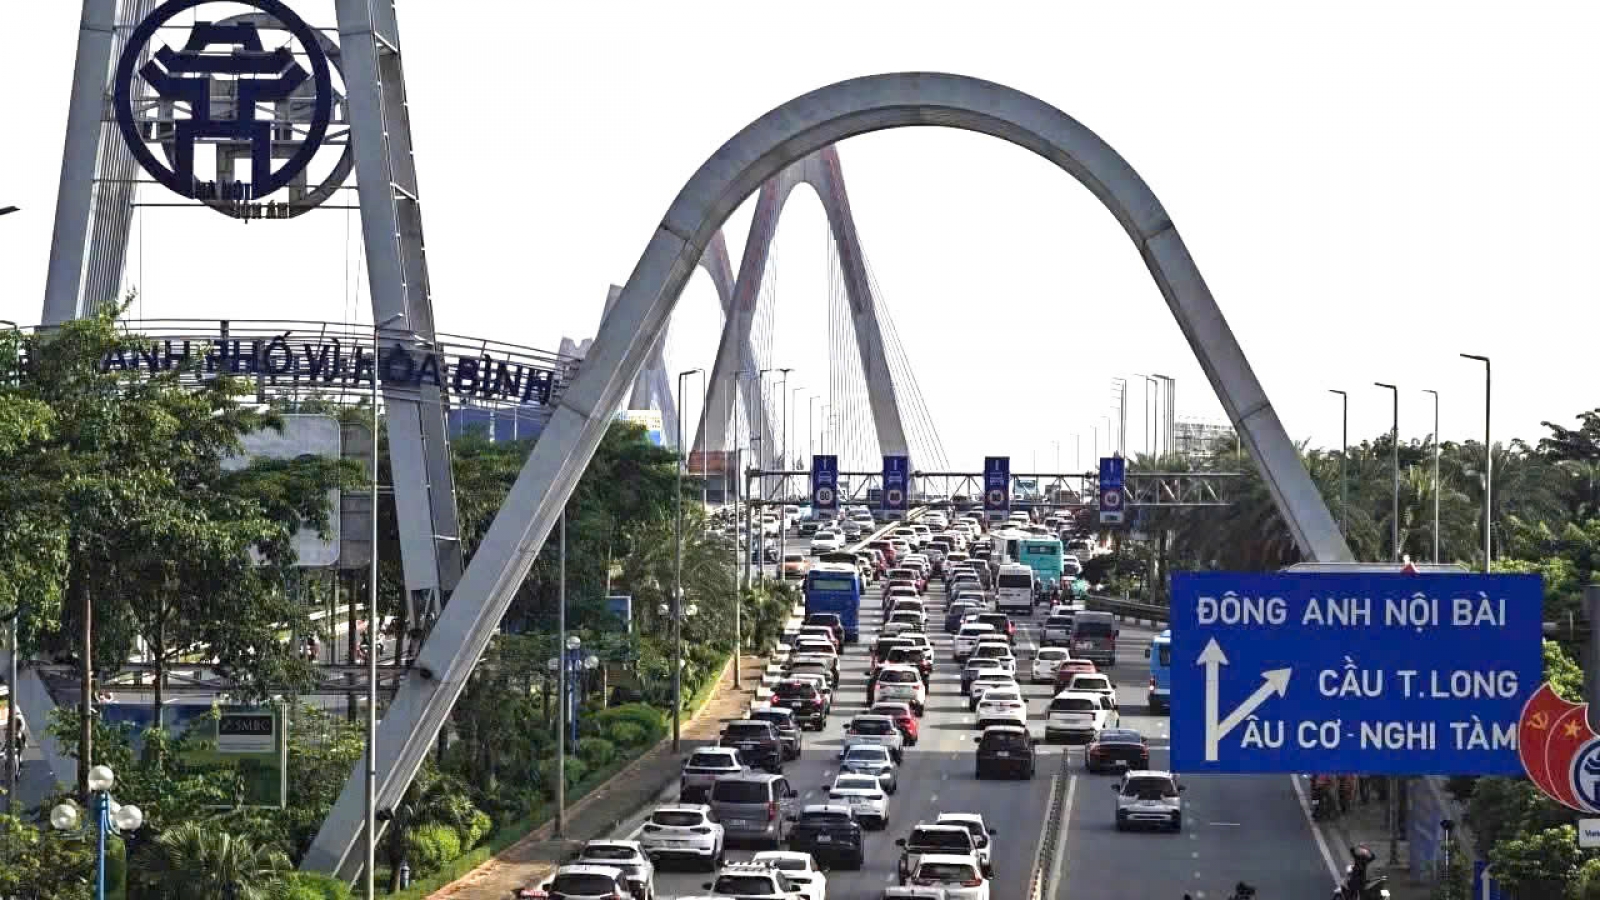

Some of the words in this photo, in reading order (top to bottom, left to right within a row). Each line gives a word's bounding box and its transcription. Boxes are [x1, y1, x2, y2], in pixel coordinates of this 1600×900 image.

[458, 354, 553, 404] BÌNH
[1196, 590, 1287, 625] ĐÔNG
[1302, 598, 1371, 626] ANH
[1385, 592, 1439, 633] NỘI
[1453, 590, 1506, 626] BÀI
[1319, 655, 1383, 697] CẦU
[1397, 670, 1519, 698] T.LONG
[1240, 715, 1284, 749] ÂU
[1450, 715, 1519, 750] TÀM
